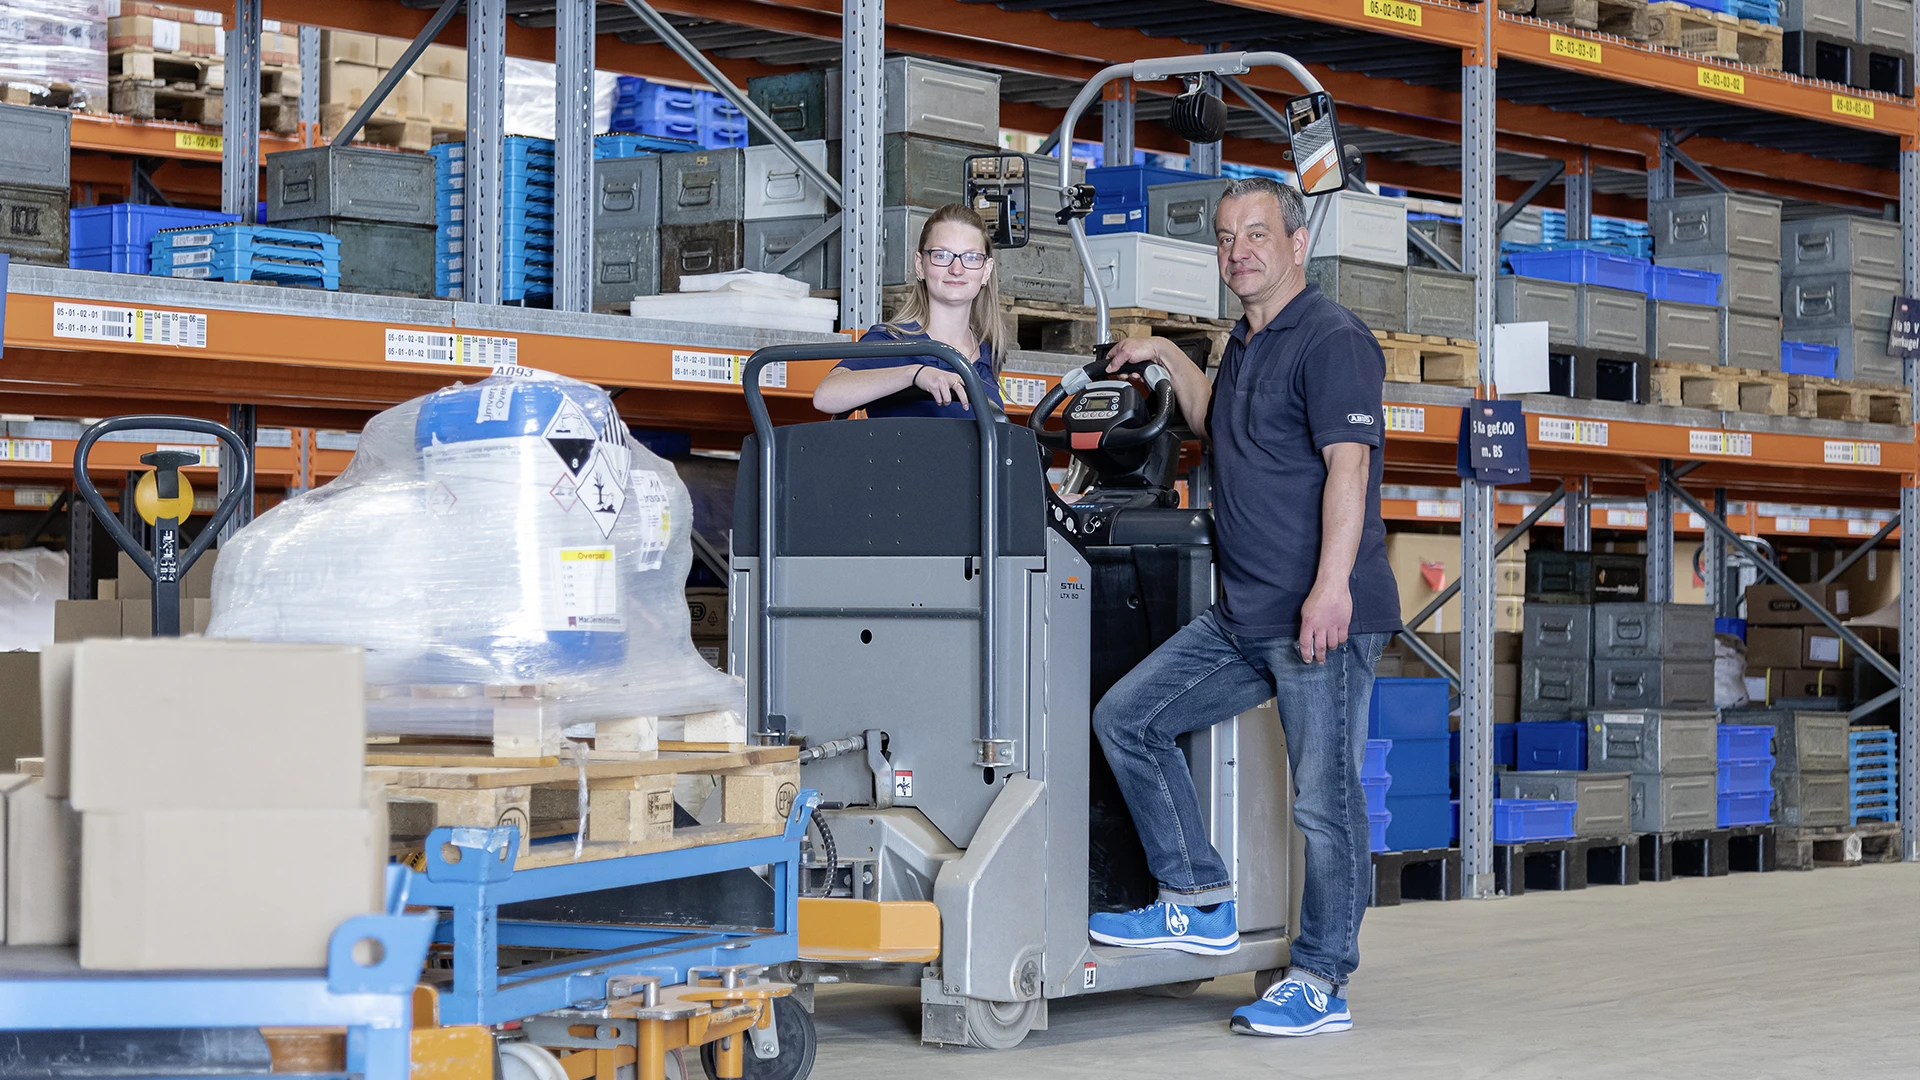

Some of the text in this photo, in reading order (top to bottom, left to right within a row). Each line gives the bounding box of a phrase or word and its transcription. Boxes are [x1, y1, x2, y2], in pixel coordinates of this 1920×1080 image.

[1370, 1, 1416, 21] 05-02-03-03
[1556, 39, 1596, 58] 05-03-03-01
[1703, 72, 1740, 90] 05-03-03-02
[136, 310, 143, 318] 03
[1487, 421, 1515, 437] gef.00
[1481, 445, 1503, 458] m. BS
[572, 458, 579, 468] 8
